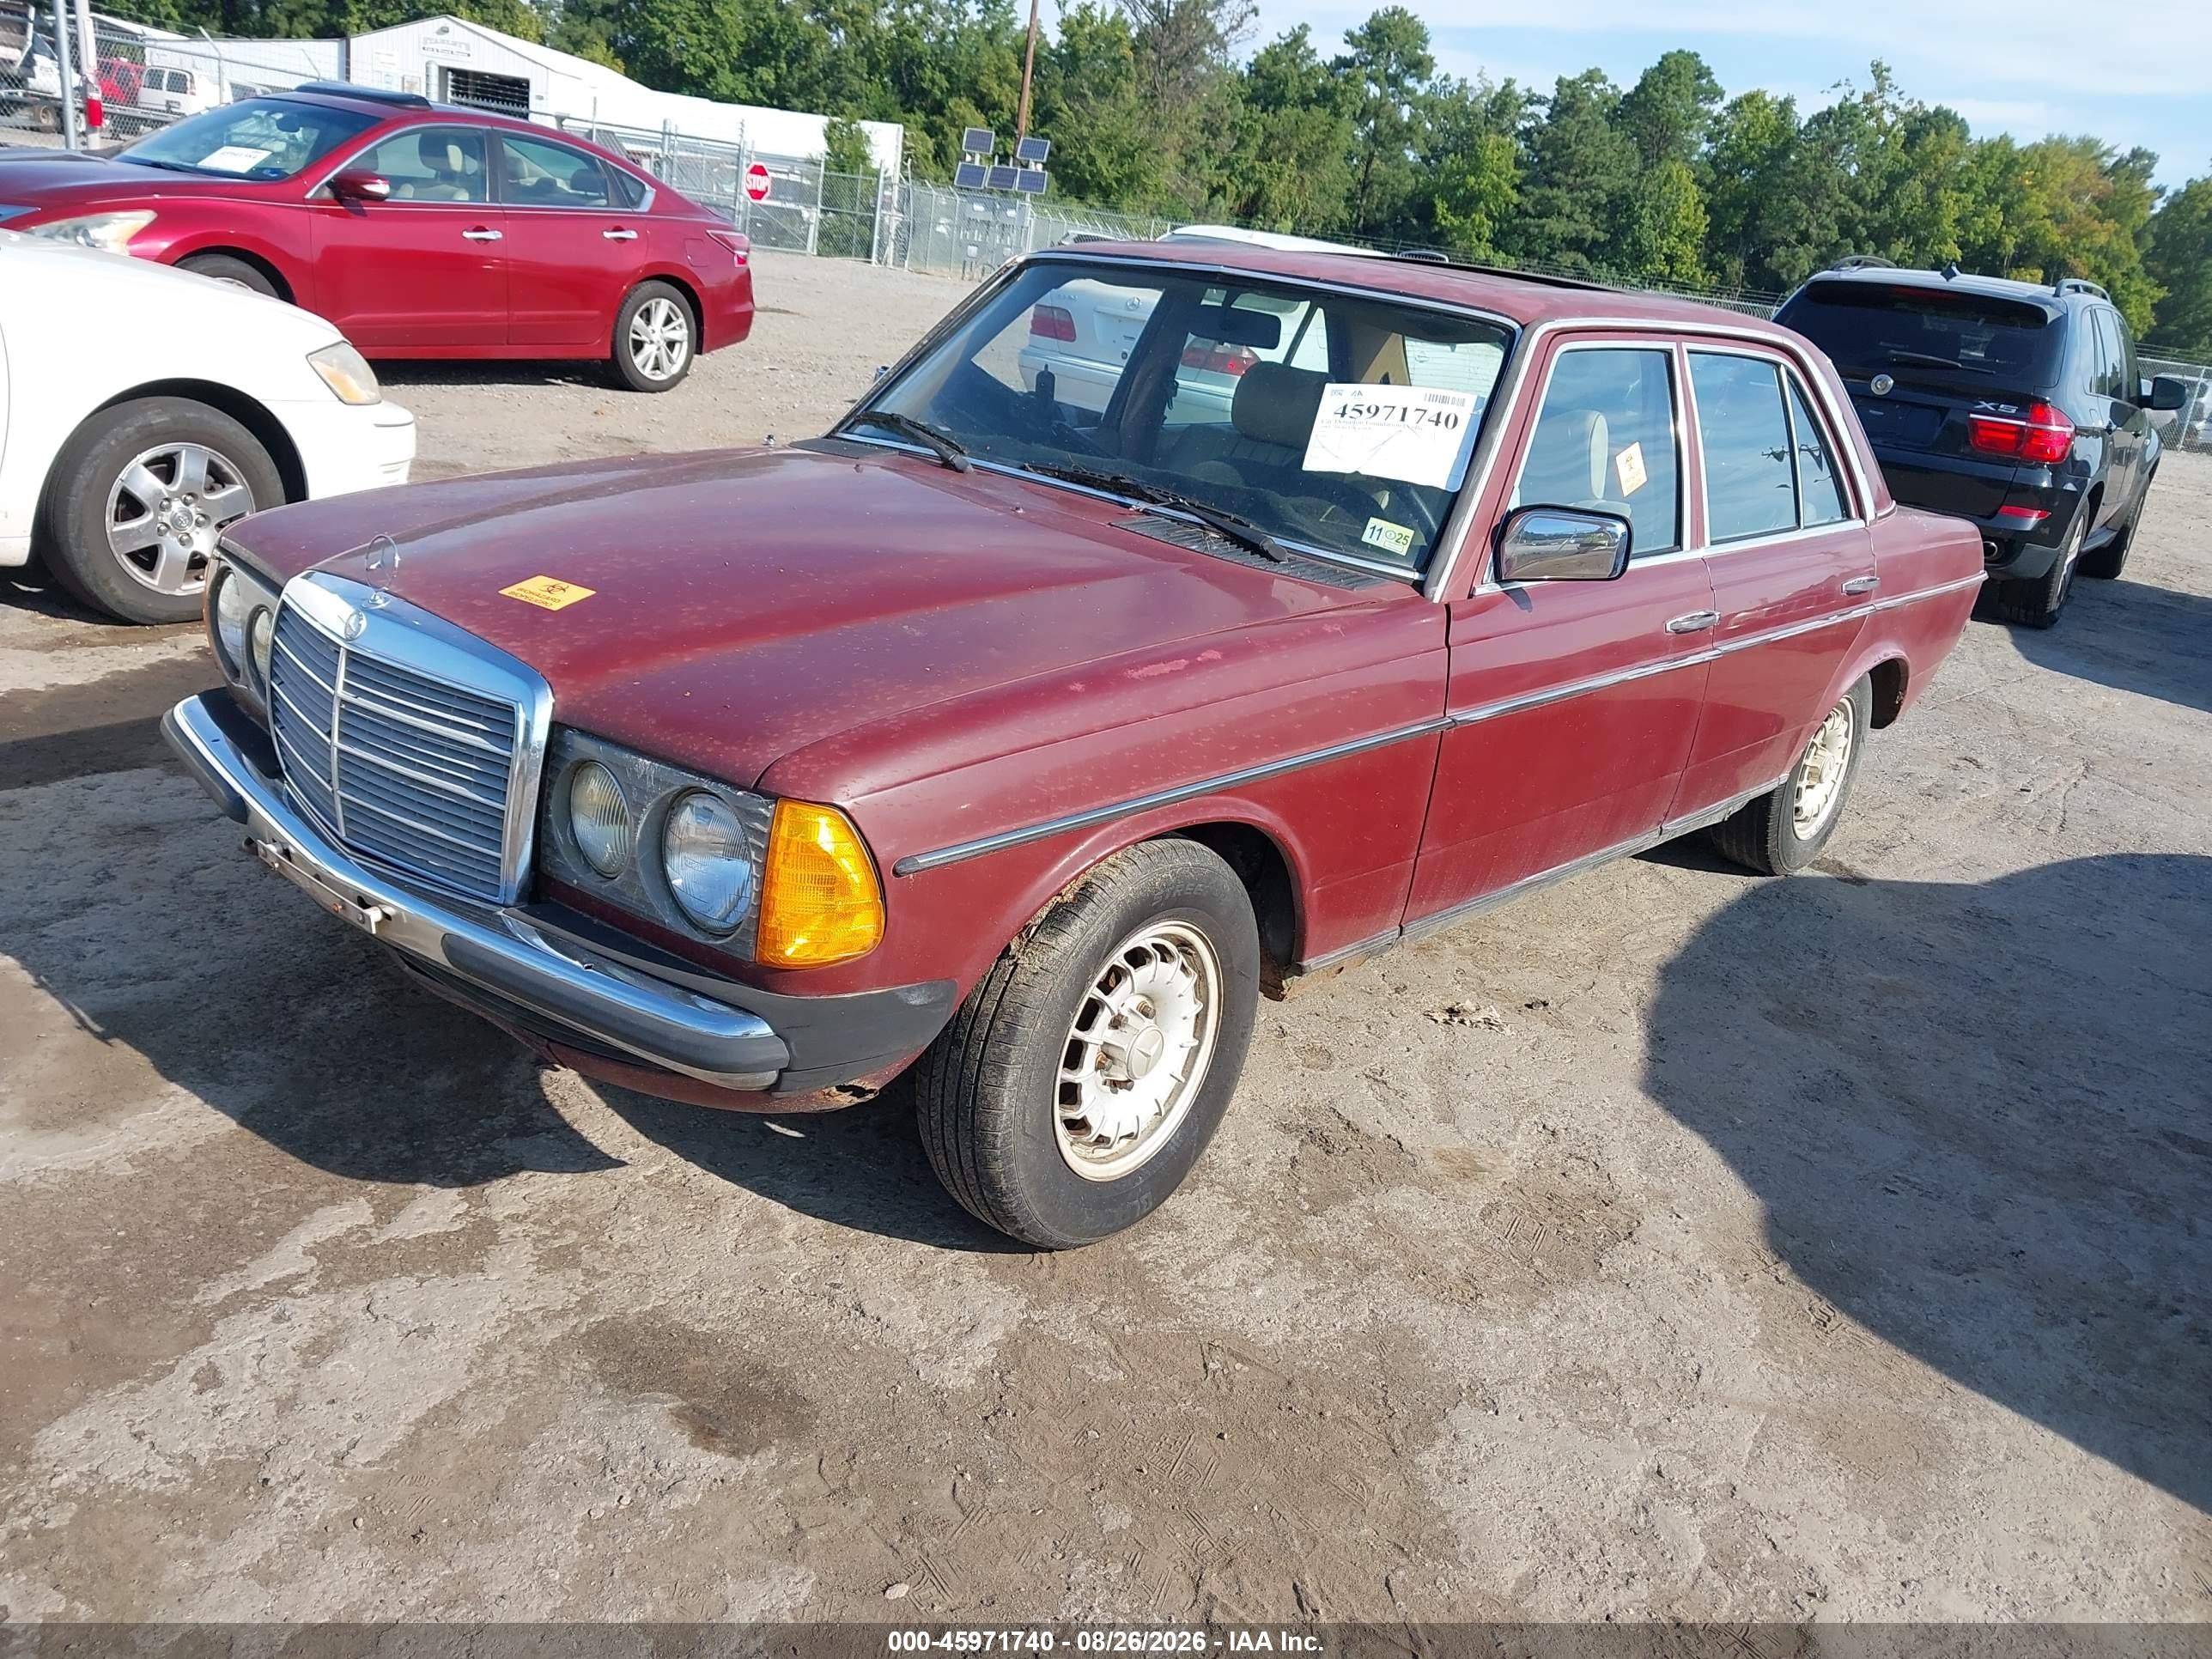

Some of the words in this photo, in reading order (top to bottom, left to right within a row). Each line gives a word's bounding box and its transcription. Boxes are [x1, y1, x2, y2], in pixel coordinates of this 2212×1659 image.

[746, 173, 769, 191] STOP
[1333, 403, 1459, 430] 45971740
[1973, 400, 2019, 414] X5
[1370, 525, 1383, 541] 11
[1395, 532, 1410, 545] 25
